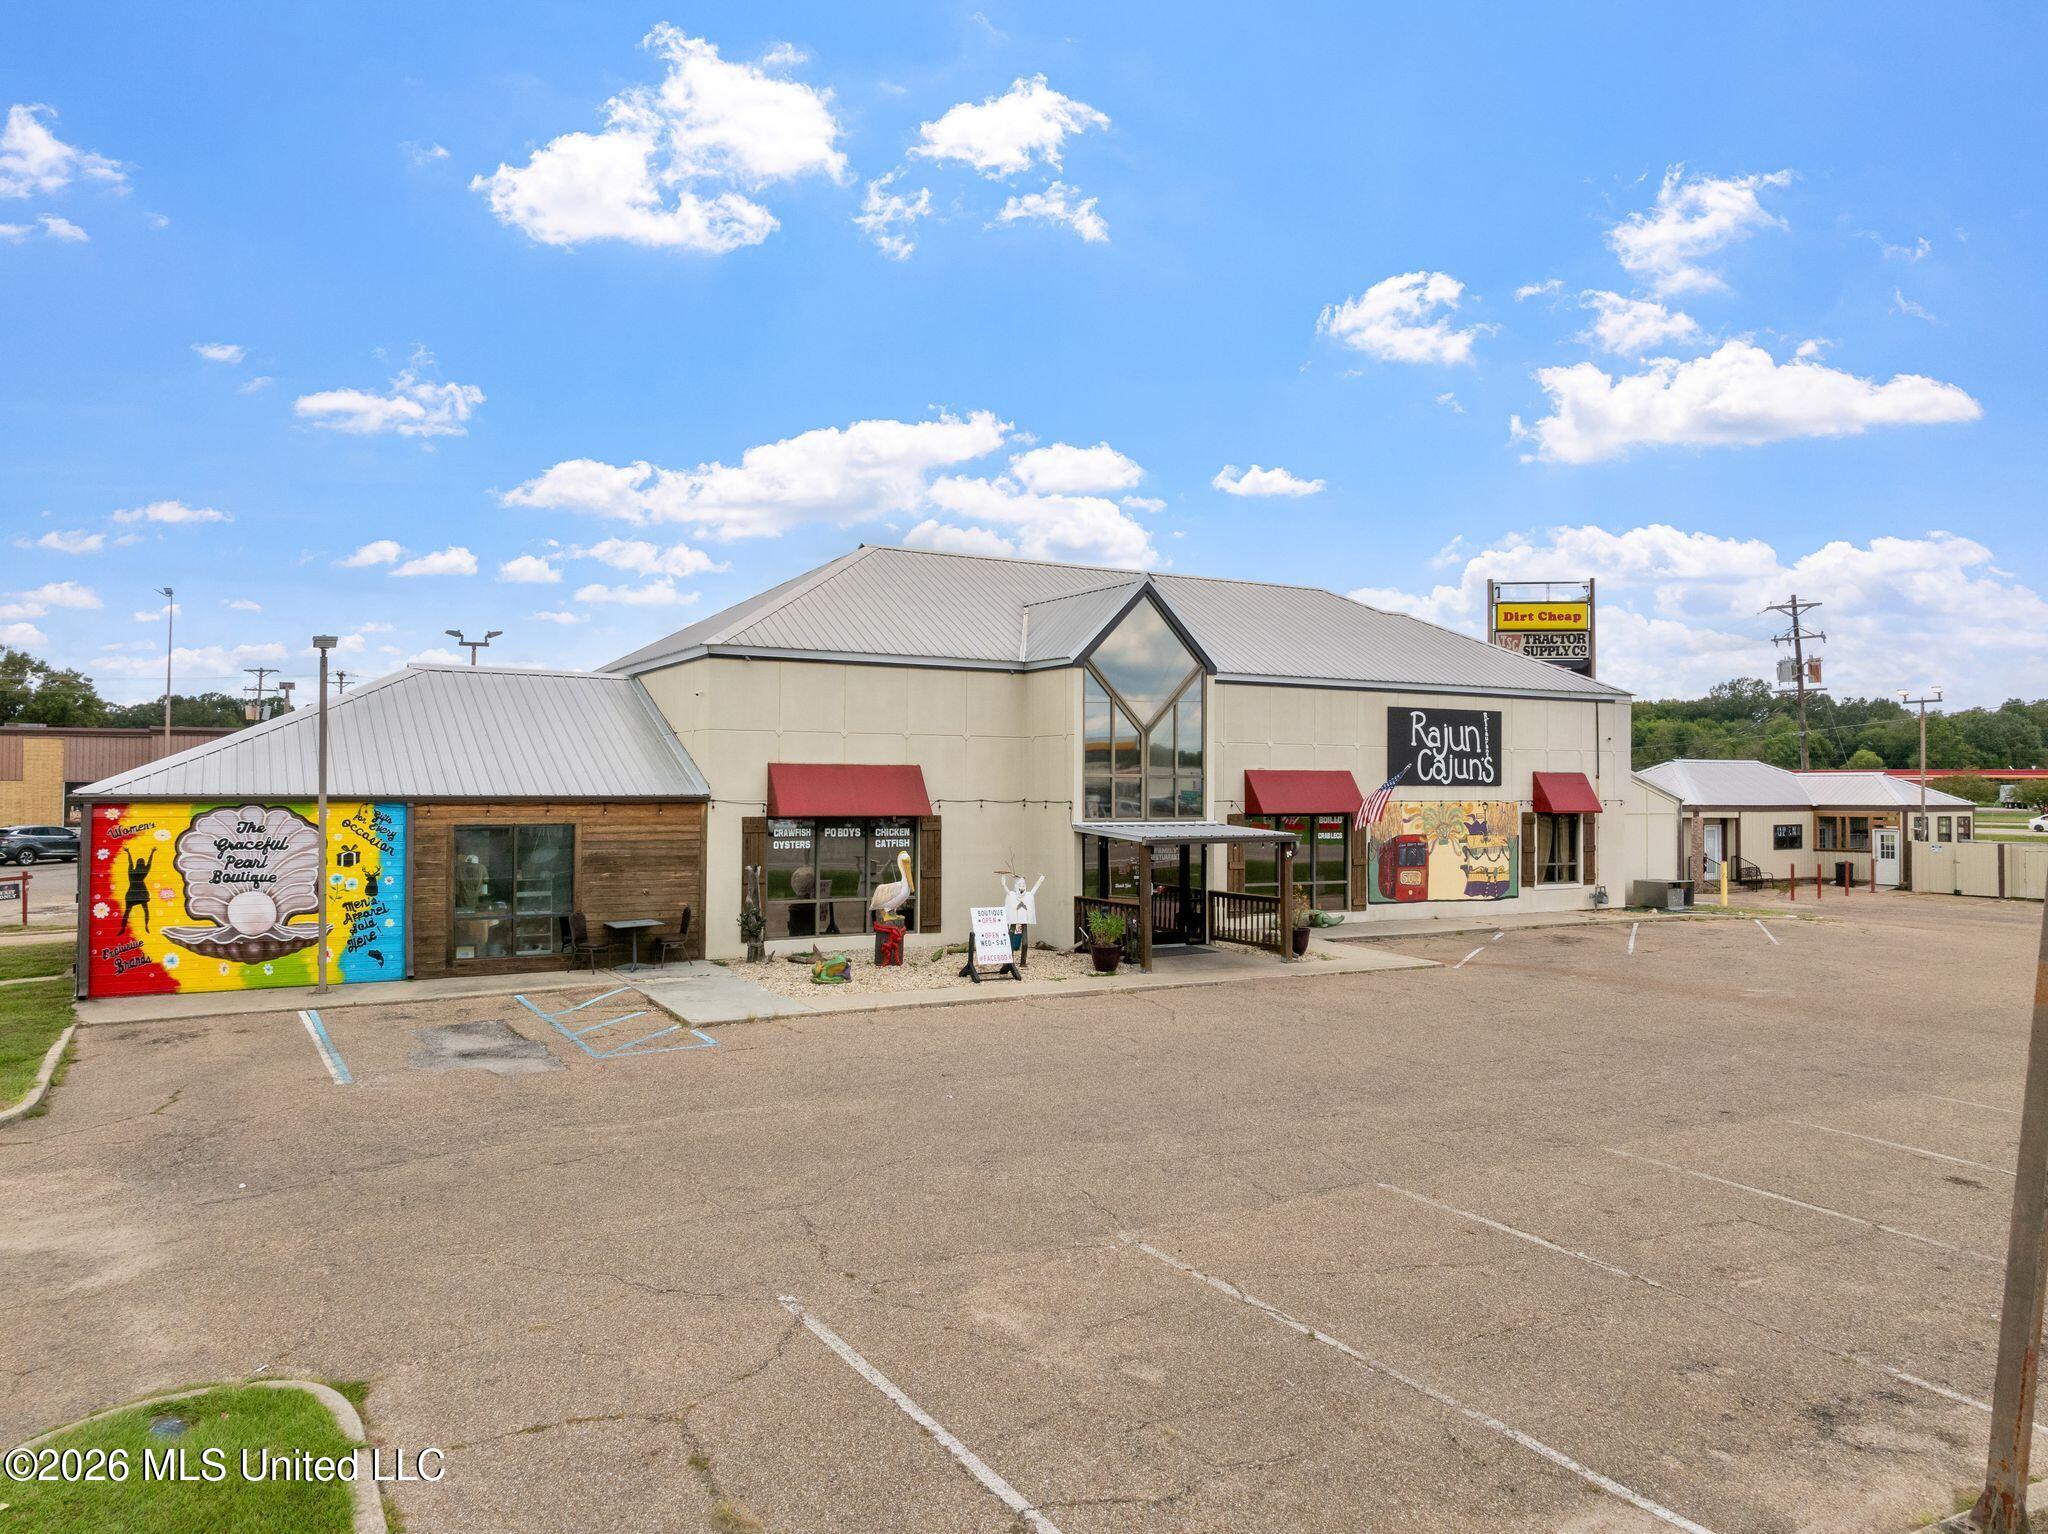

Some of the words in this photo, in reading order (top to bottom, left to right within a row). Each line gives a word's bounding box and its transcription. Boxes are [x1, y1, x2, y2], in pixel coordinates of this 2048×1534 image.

[1503, 611, 1534, 621] Dirt
[1537, 611, 1582, 623] Cheap
[1523, 633, 1587, 645] TRACTOR
[1523, 645, 1571, 657] SUPPLY
[1410, 710, 1482, 759] Rajun
[1417, 748, 1495, 785] Cajun's
[106, 821, 156, 839] Women's
[236, 821, 267, 835] The
[369, 821, 398, 842] Every
[773, 828, 812, 838] CRAWFISH
[824, 827, 836, 838] PO
[836, 827, 861, 838] BOYS
[875, 827, 911, 837] CHICKEN
[213, 836, 290, 857] Graceful
[773, 840, 811, 850] OYSTERS
[875, 838, 910, 848] CATFISH
[224, 855, 268, 870] Pearl
[208, 870, 278, 889] Boutique
[343, 902, 390, 926] Apparel
[349, 917, 378, 936] Sold
[113, 953, 153, 976] Brands
